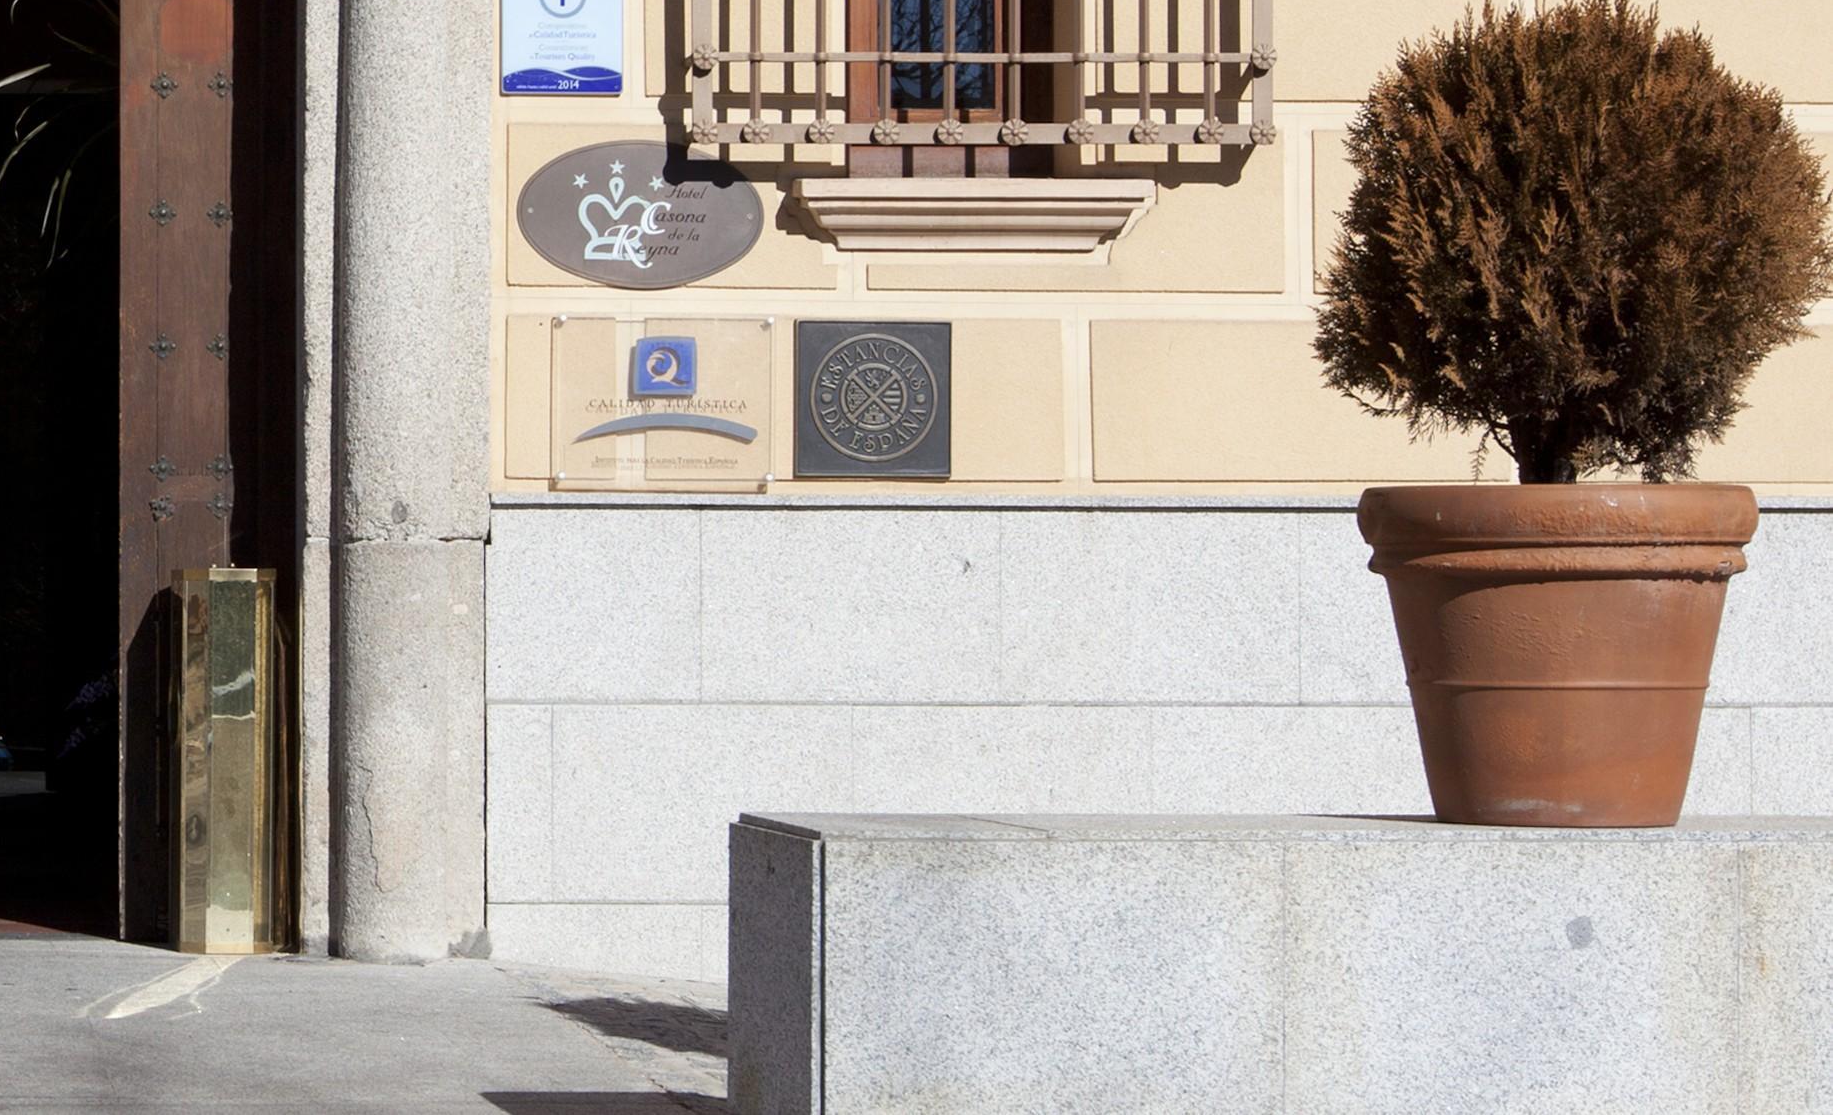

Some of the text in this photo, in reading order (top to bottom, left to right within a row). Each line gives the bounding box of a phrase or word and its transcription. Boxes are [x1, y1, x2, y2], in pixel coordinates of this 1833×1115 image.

[557, 80, 580, 90] 2014
[665, 185, 708, 199] Hotel
[641, 201, 707, 235] Casona
[668, 228, 700, 241] de la
[604, 224, 679, 269] Reyna
[821, 342, 926, 391] ESTANCIAS
[589, 399, 655, 409] CALIDAD
[821, 406, 850, 437] DE
